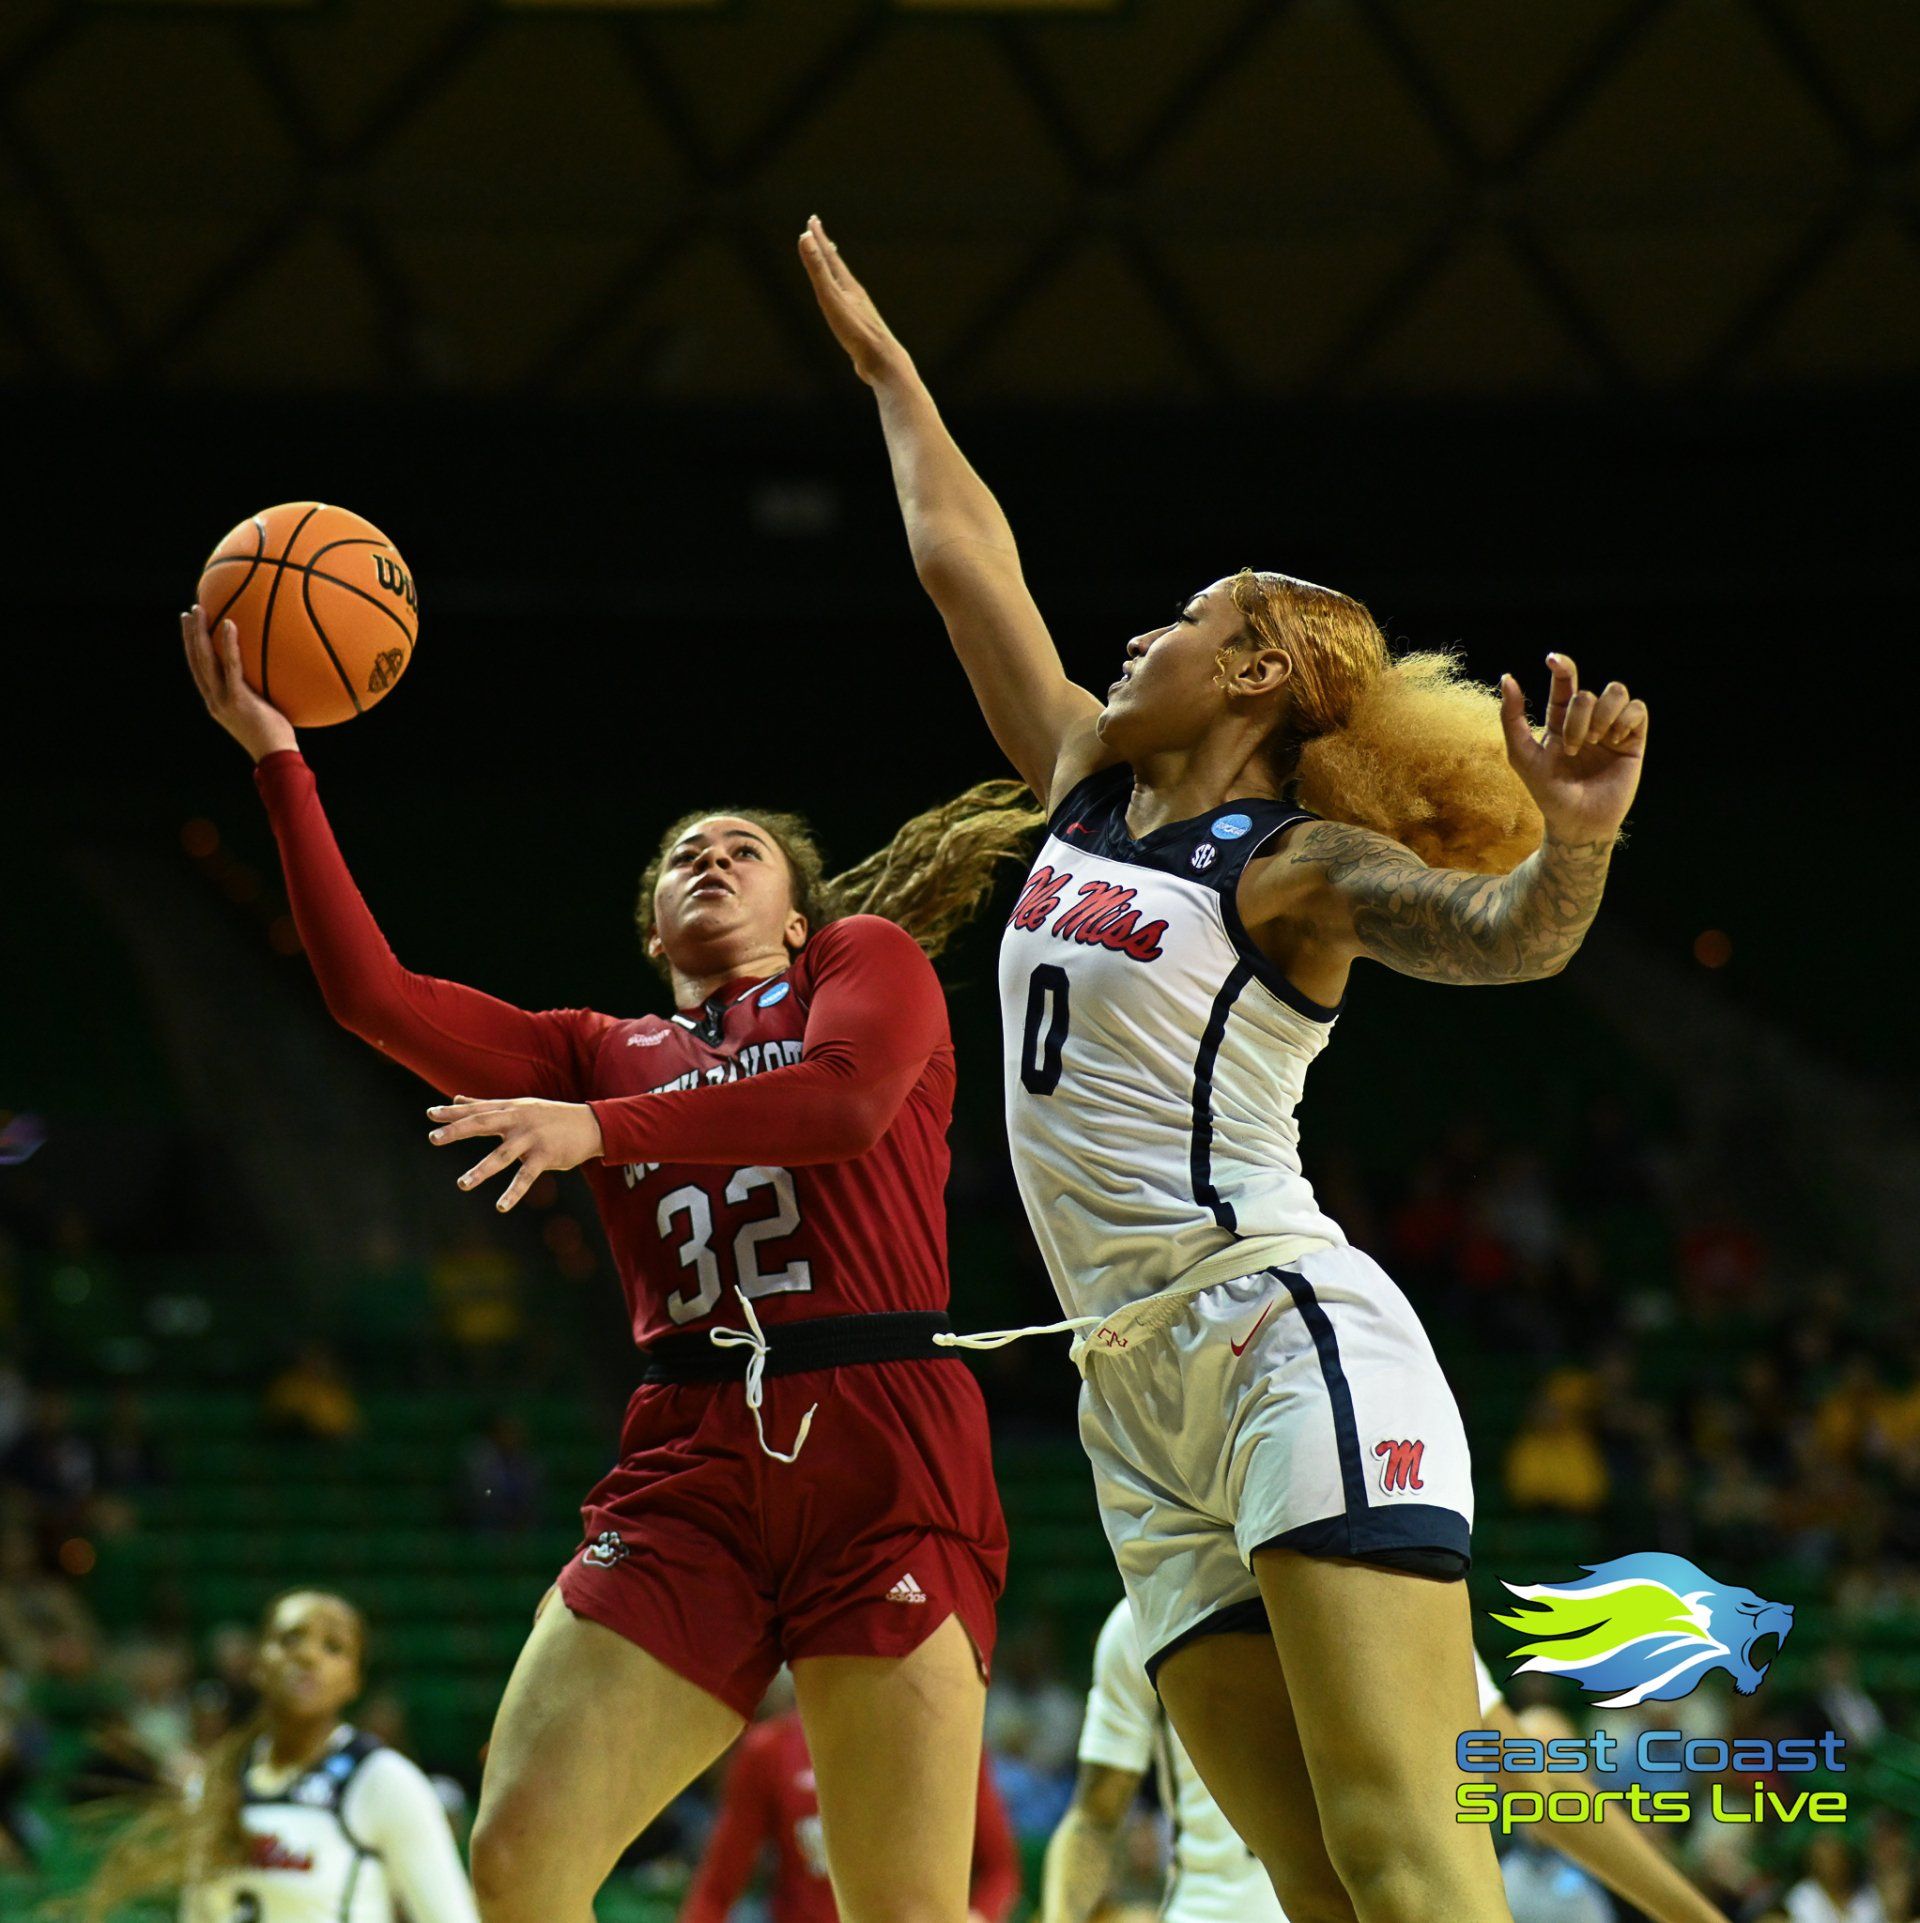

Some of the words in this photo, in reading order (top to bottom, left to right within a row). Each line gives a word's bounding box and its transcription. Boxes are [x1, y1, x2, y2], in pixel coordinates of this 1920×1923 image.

[1191, 843, 1216, 869] SEC
[1006, 865, 1073, 932] Ole
[1051, 880, 1169, 962] Miss
[1021, 963, 1069, 1096] 0
[656, 1164, 812, 1325] 32
[1372, 1439, 1425, 1495] M
[885, 1591, 927, 1603] adidas
